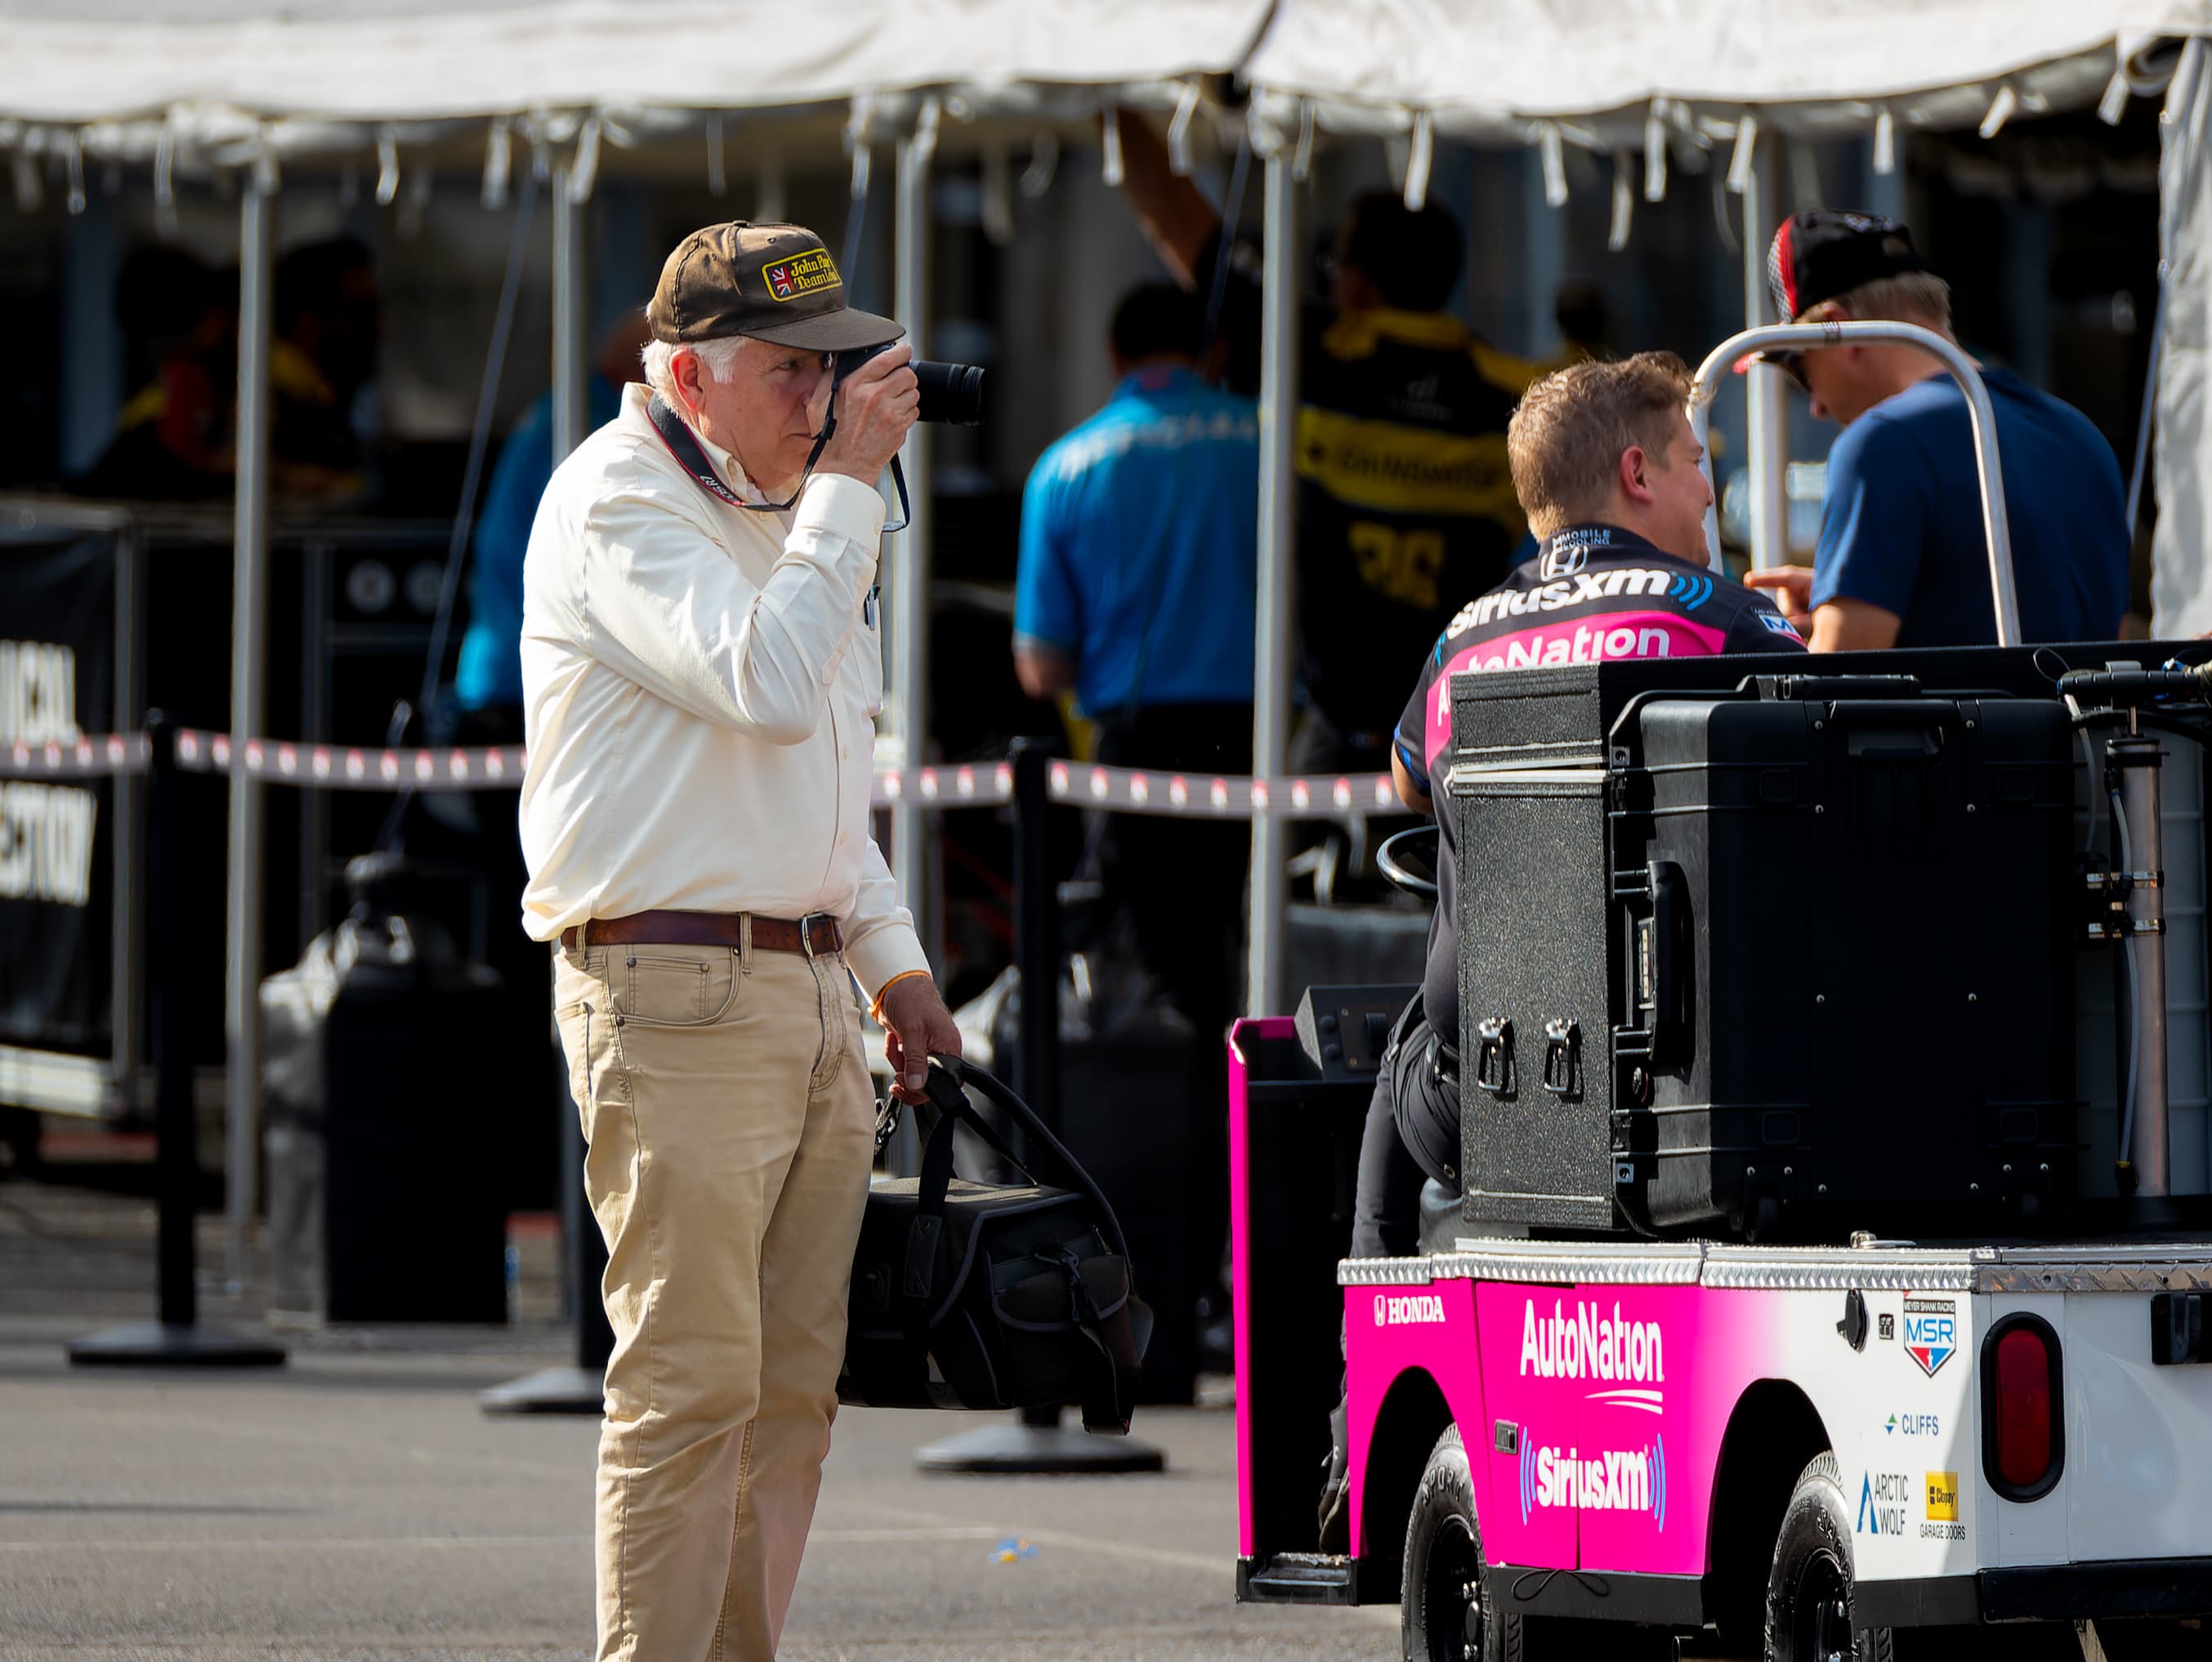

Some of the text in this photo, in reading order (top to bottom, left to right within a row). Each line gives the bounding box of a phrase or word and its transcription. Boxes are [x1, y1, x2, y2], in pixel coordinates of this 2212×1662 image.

[790, 257, 819, 277] John
[793, 272, 827, 290] Team
[1562, 529, 1611, 541] MOBILE
[1388, 1295, 1446, 1324] HONDA
[1920, 1301, 1937, 1312] SHANK
[1937, 1302, 1955, 1313] RACING
[1520, 1298, 1664, 1382] AutoNation
[1906, 1318, 1953, 1343] MSR
[1902, 1414, 1938, 1436] CLIFFS
[1875, 1473, 1908, 1502] ARCTIC
[1937, 1487, 1955, 1508] Clopay
[1879, 1508, 1906, 1535] WOLF
[1920, 1524, 1966, 1540] GARAGE DOORS
